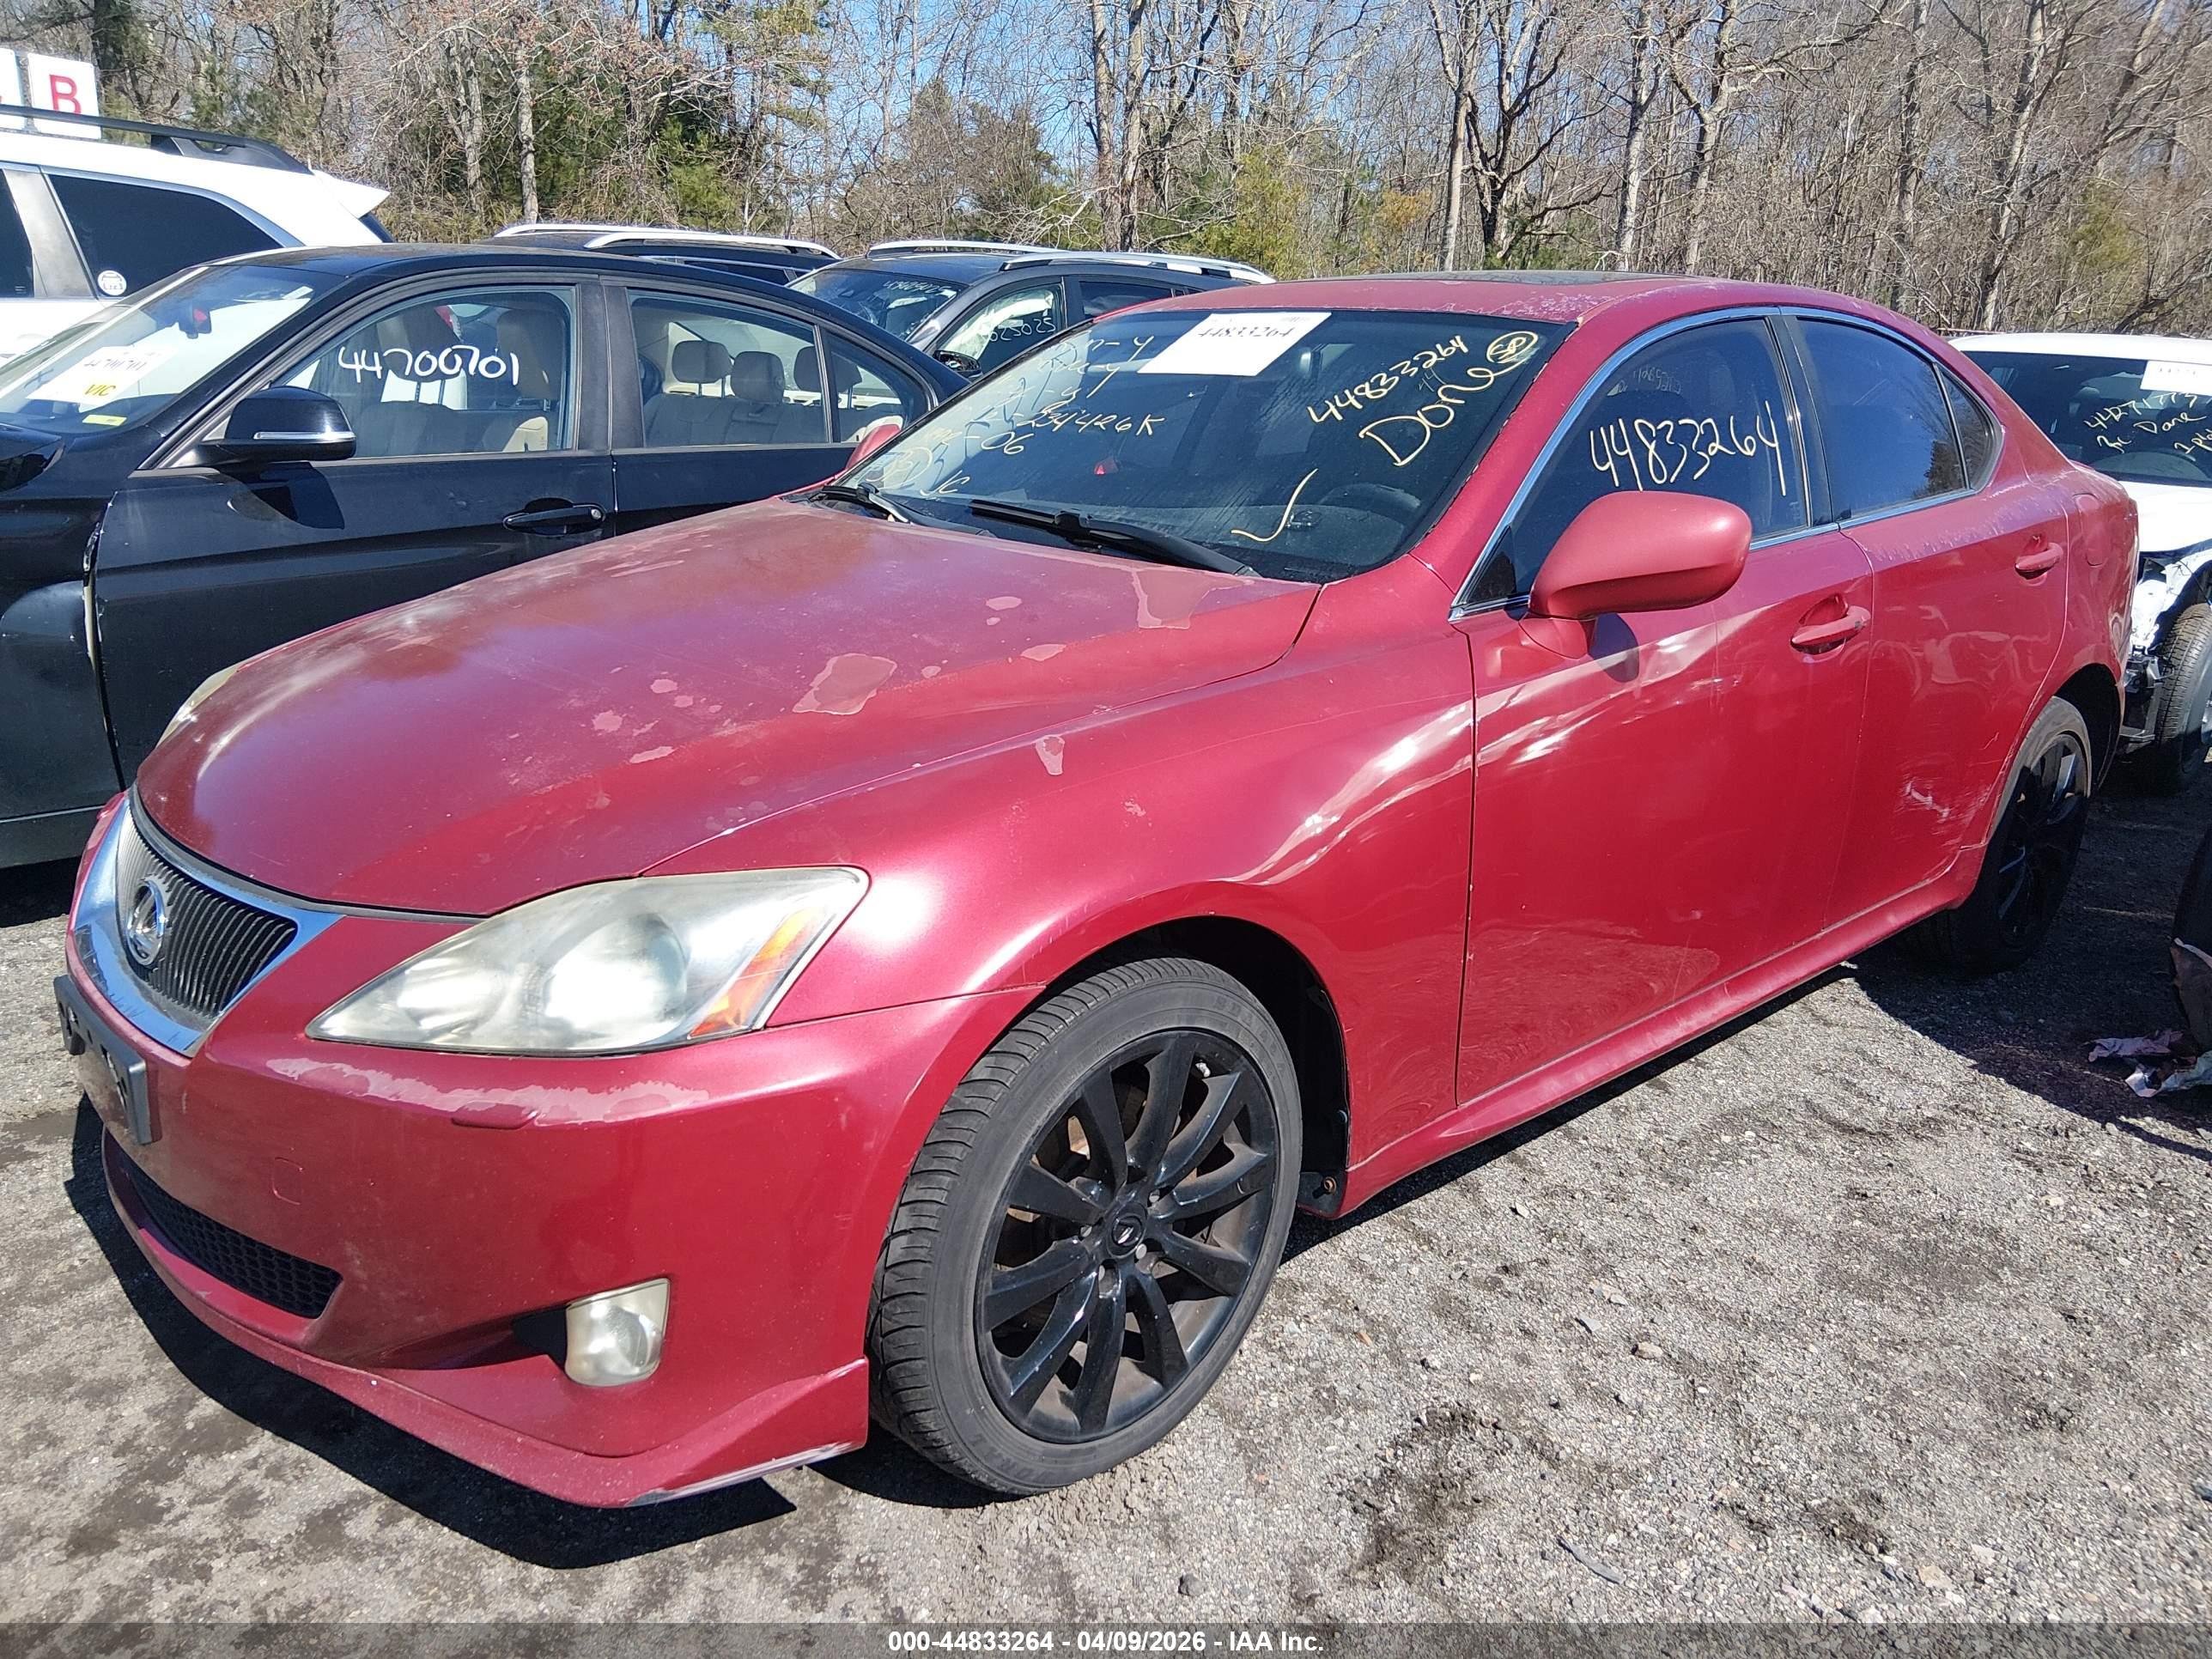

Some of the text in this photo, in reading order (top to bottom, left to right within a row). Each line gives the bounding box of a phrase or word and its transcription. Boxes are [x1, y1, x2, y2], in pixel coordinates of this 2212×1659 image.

[337, 344, 520, 386] 44700701
[1307, 335, 1468, 423] 44833264
[1590, 400, 1785, 497] 44833264
